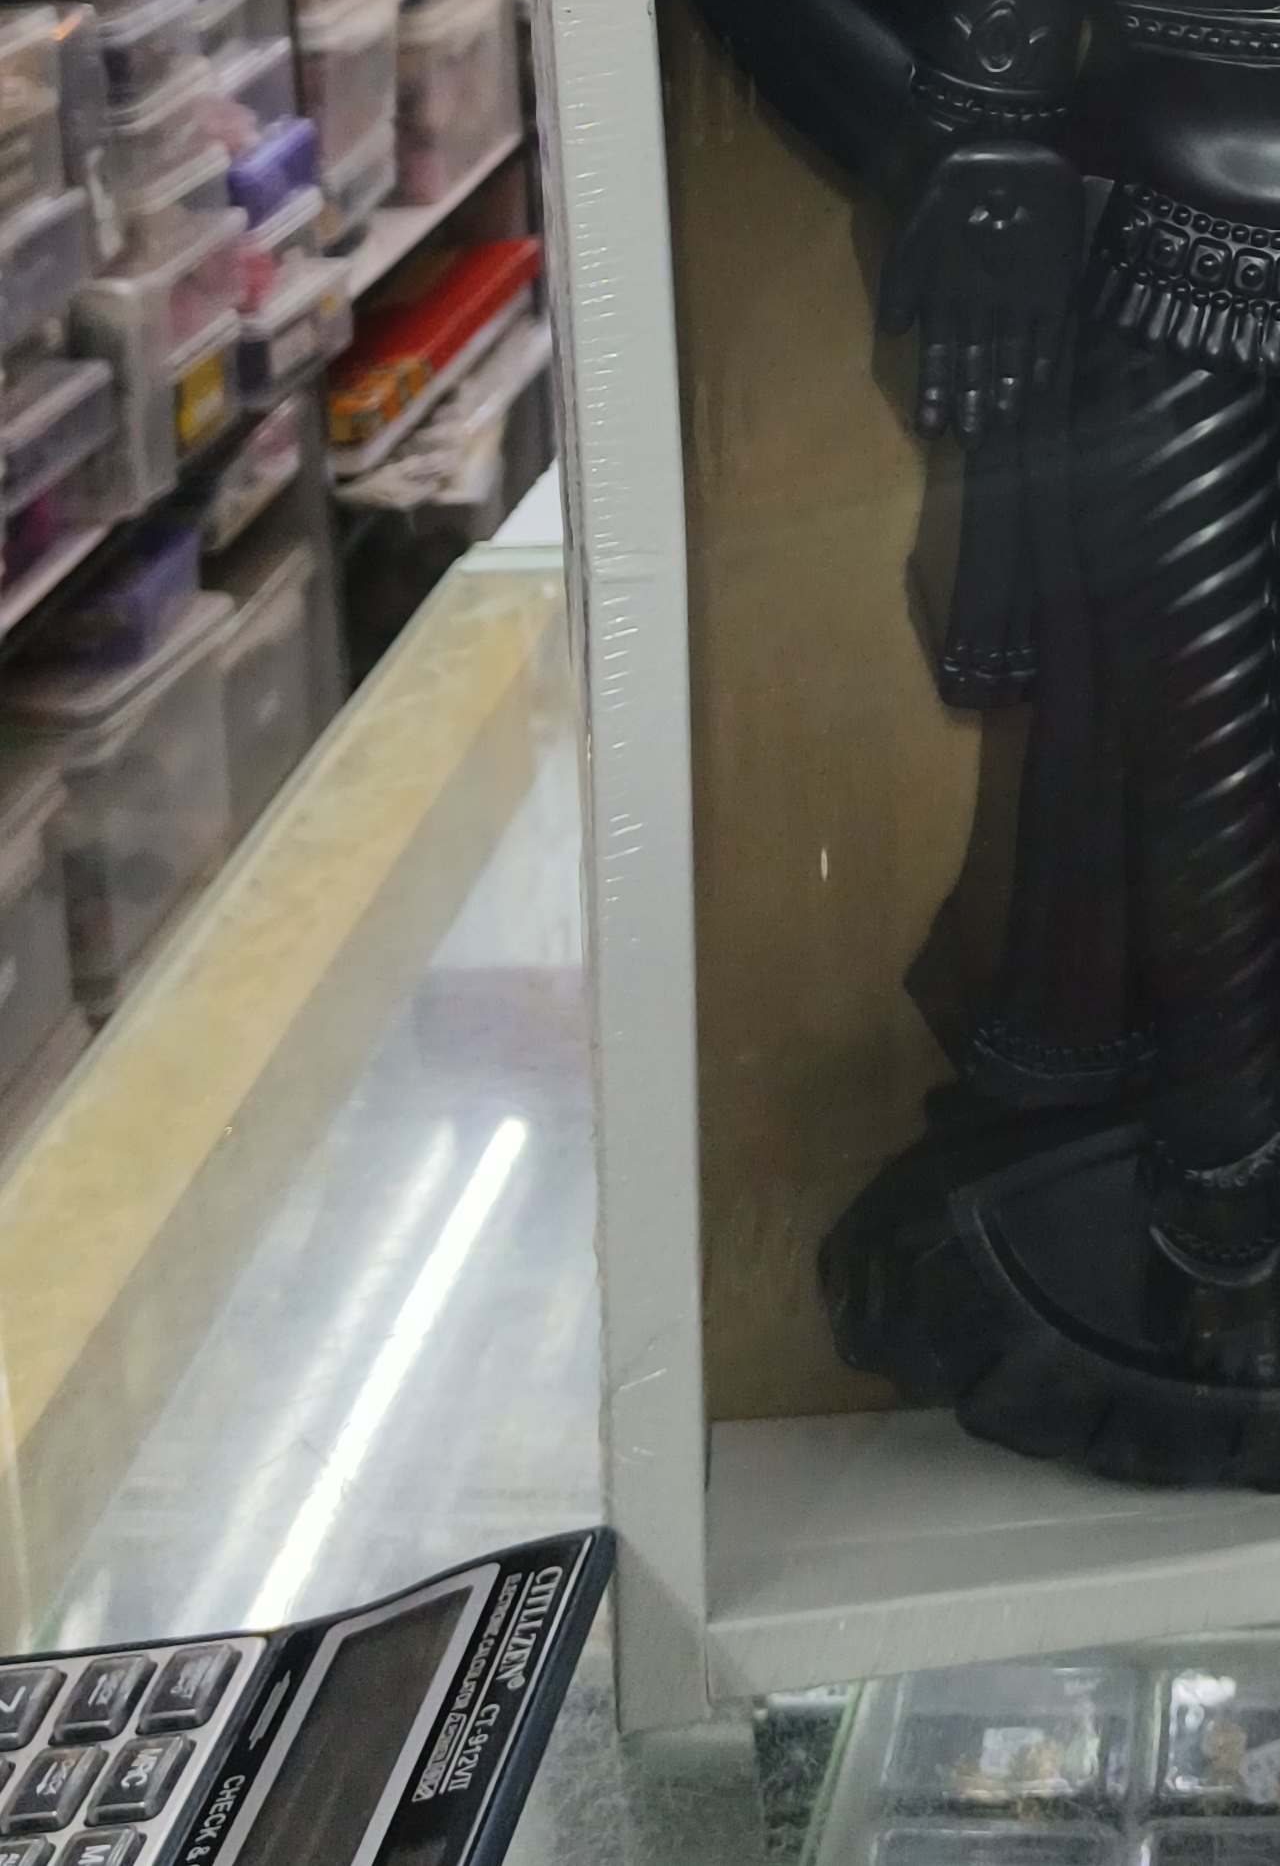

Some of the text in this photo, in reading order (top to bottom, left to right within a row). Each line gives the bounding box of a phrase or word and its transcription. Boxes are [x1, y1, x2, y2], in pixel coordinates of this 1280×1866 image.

[121, 1748, 163, 1789] MRC
[448, 1704, 500, 1791] CT-912VII
[186, 1775, 245, 1862] CHECK &
